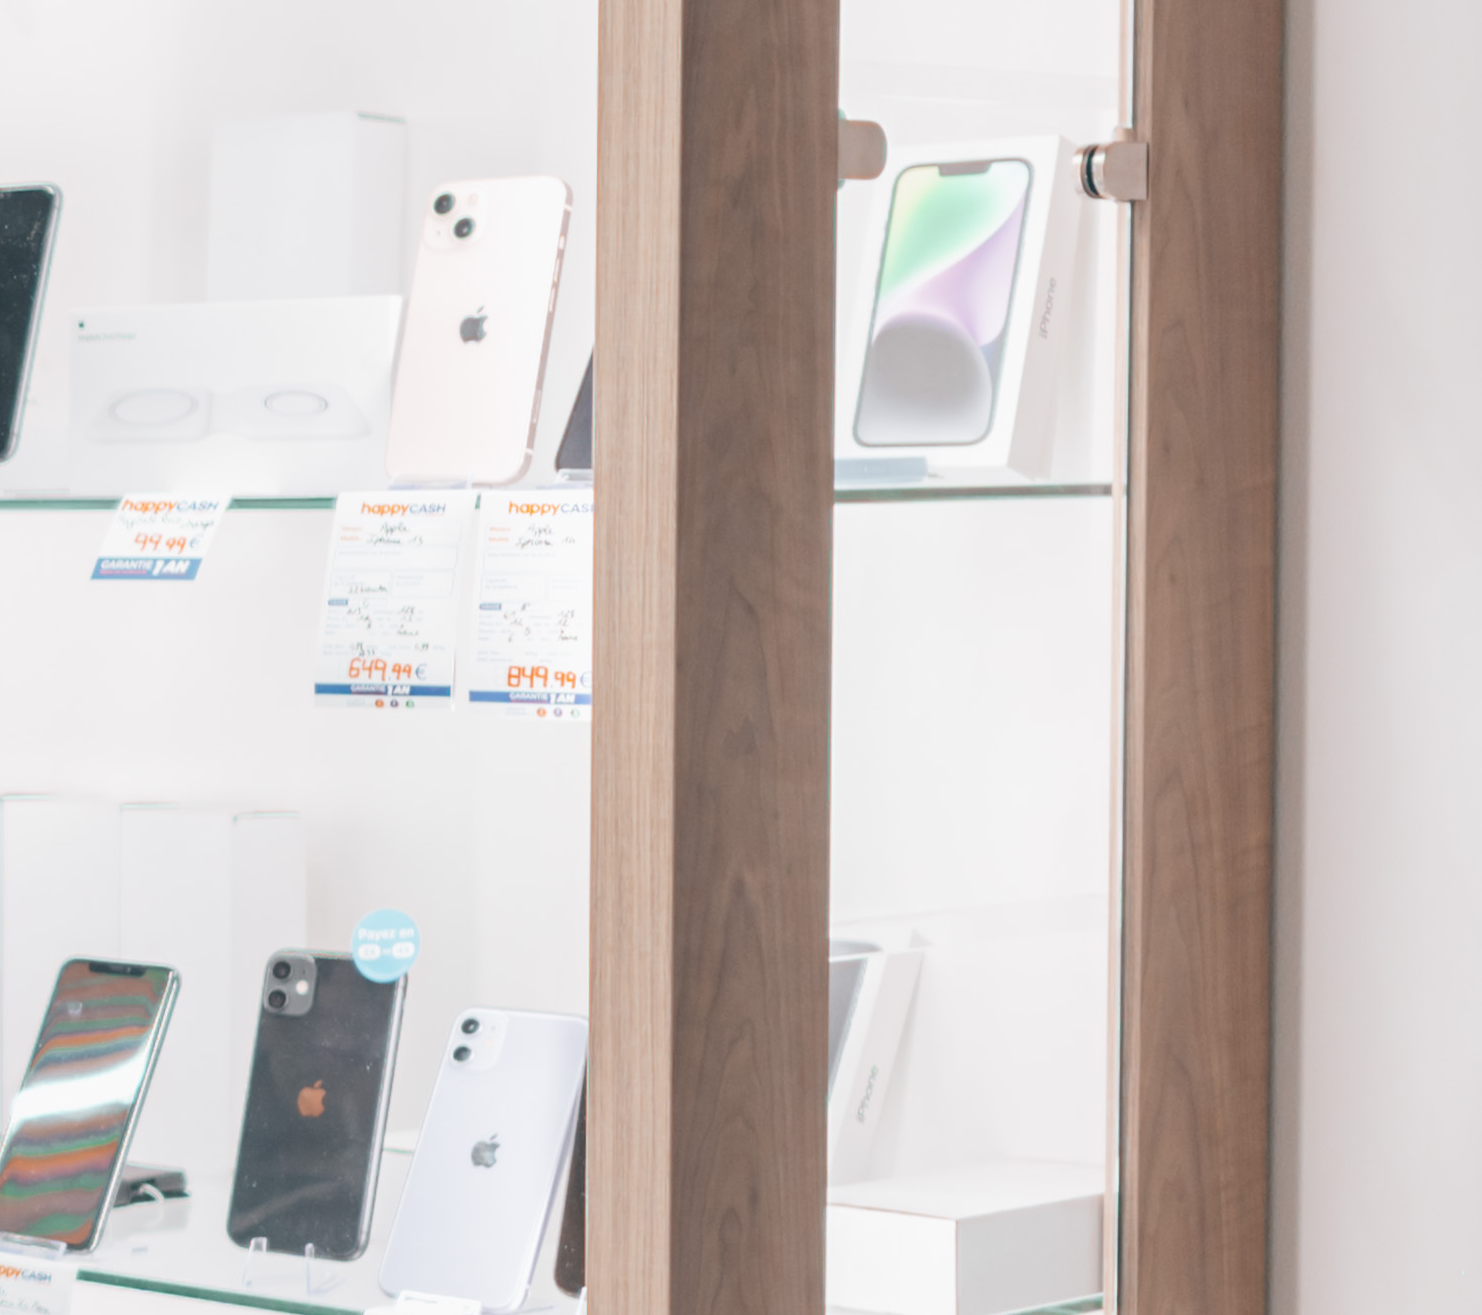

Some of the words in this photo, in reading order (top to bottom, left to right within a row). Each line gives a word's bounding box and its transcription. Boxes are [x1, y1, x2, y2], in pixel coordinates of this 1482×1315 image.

[1038, 277, 1057, 340] iPhone
[122, 499, 219, 514] happyCASH
[361, 502, 446, 516] happyCASH
[101, 560, 153, 570] GARANTIE
[350, 685, 386, 694] GARANTIE
[509, 692, 548, 702] GARANTIE
[358, 928, 396, 942] Payez
[399, 928, 414, 939] en
[856, 1064, 879, 1125] iPhone
